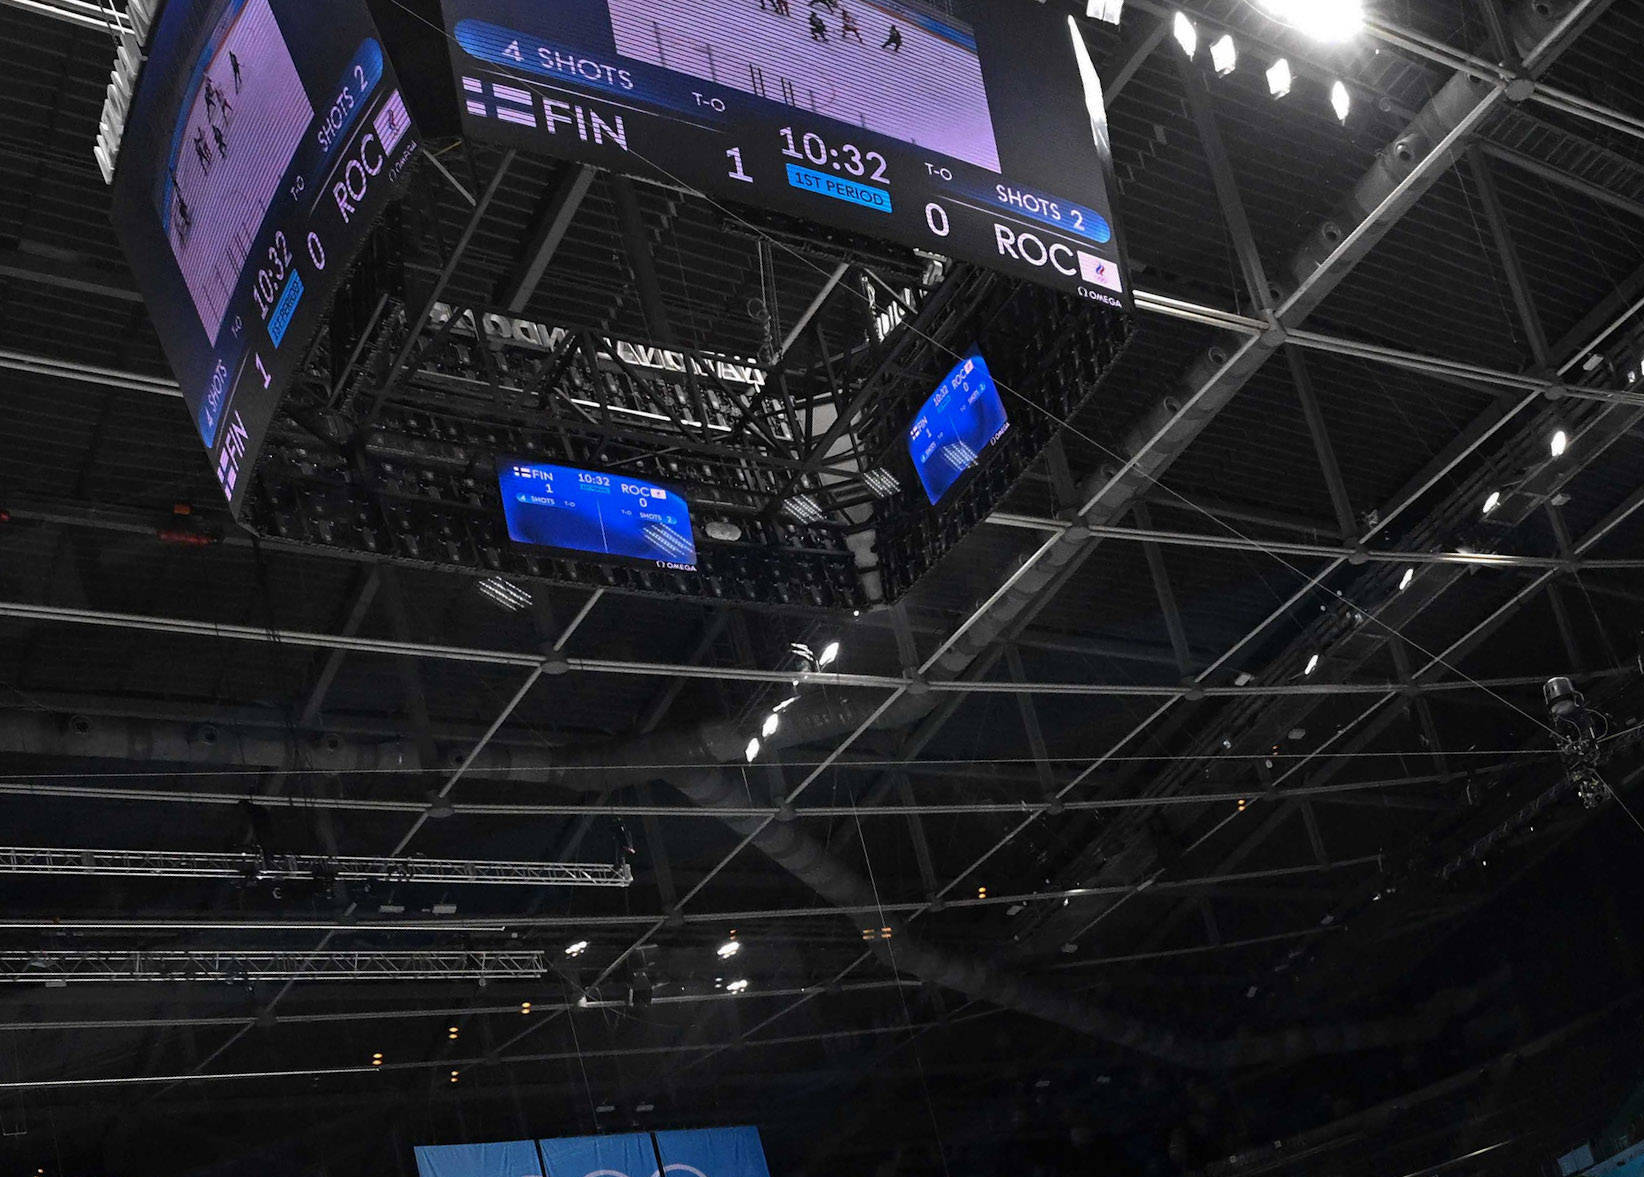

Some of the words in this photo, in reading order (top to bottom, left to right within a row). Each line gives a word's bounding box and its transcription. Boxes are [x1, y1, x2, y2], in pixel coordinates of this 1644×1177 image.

[502, 39, 525, 62] 4
[537, 47, 634, 90] SHOTS
[316, 86, 355, 153] SHOTS
[354, 65, 369, 92] 2
[692, 91, 726, 112] T-O
[542, 98, 628, 151] FIN
[726, 146, 753, 183] 1
[779, 126, 891, 185] 10:32
[925, 162, 953, 181] T-O
[332, 133, 383, 224] ROC
[795, 172, 821, 189] 1ST
[826, 179, 884, 206] PERIOD
[924, 202, 950, 237] 0
[995, 184, 1062, 221] SHOTS
[1070, 209, 1086, 232] 2
[307, 231, 326, 271] 0
[993, 223, 1077, 277] ROC
[252, 230, 294, 321] 10:32
[1088, 289, 1123, 309] OMEGA
[207, 358, 228, 414] SHOTS
[255, 351, 272, 390] 1
[224, 409, 249, 472] FIN
[532, 469, 554, 482] FIN
[578, 473, 611, 487] 10:32
[620, 483, 651, 498] ROC
[545, 483, 554, 494] 1
[639, 497, 648, 508] 0
[666, 562, 698, 572] OMEGA
